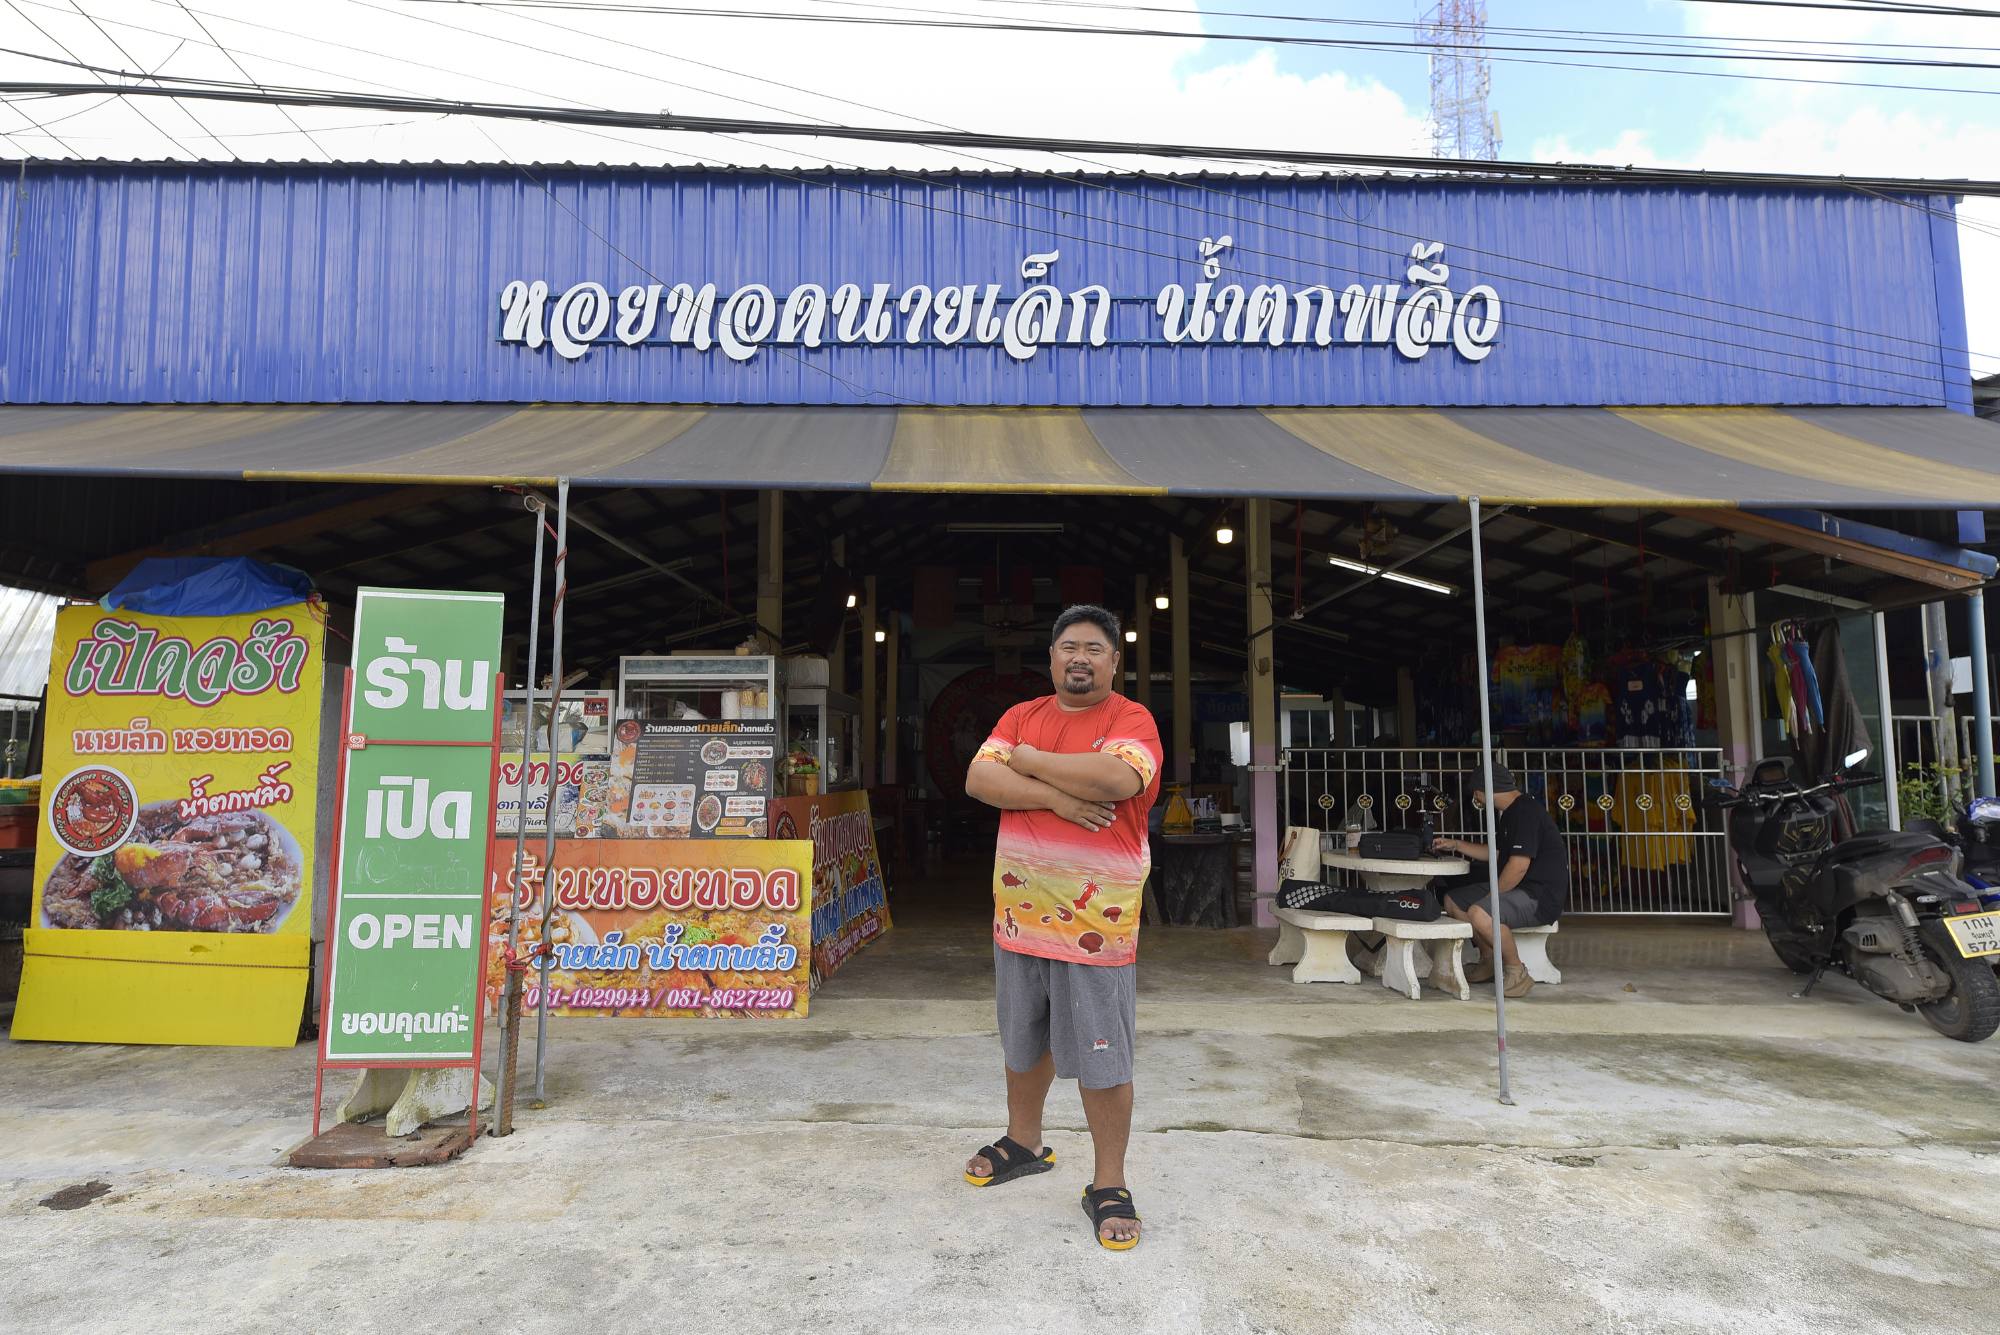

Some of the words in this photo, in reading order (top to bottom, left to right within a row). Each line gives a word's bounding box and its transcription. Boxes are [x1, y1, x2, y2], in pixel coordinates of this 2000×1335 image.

[500, 249, 1110, 360] หอยทอดนายเล็ก
[1156, 235, 1501, 360] น้ำตกพลิ้ว
[364, 636, 490, 711] ร้าน
[74, 718, 166, 752] นายเล็ก
[174, 729, 292, 752] หอยทอด
[179, 762, 291, 819] น้ำตกพลิ้ว
[364, 775, 473, 840] เปิด
[507, 850, 801, 910] ร้านหอยทอด
[348, 913, 473, 950] OPEN
[647, 923, 798, 970] น้ำตกพลิ้ว
[1968, 941, 2000, 953] 572
[667, 989, 793, 1009] 081-8627220
[341, 1004, 470, 1042] ขอบคุณค่ะ
